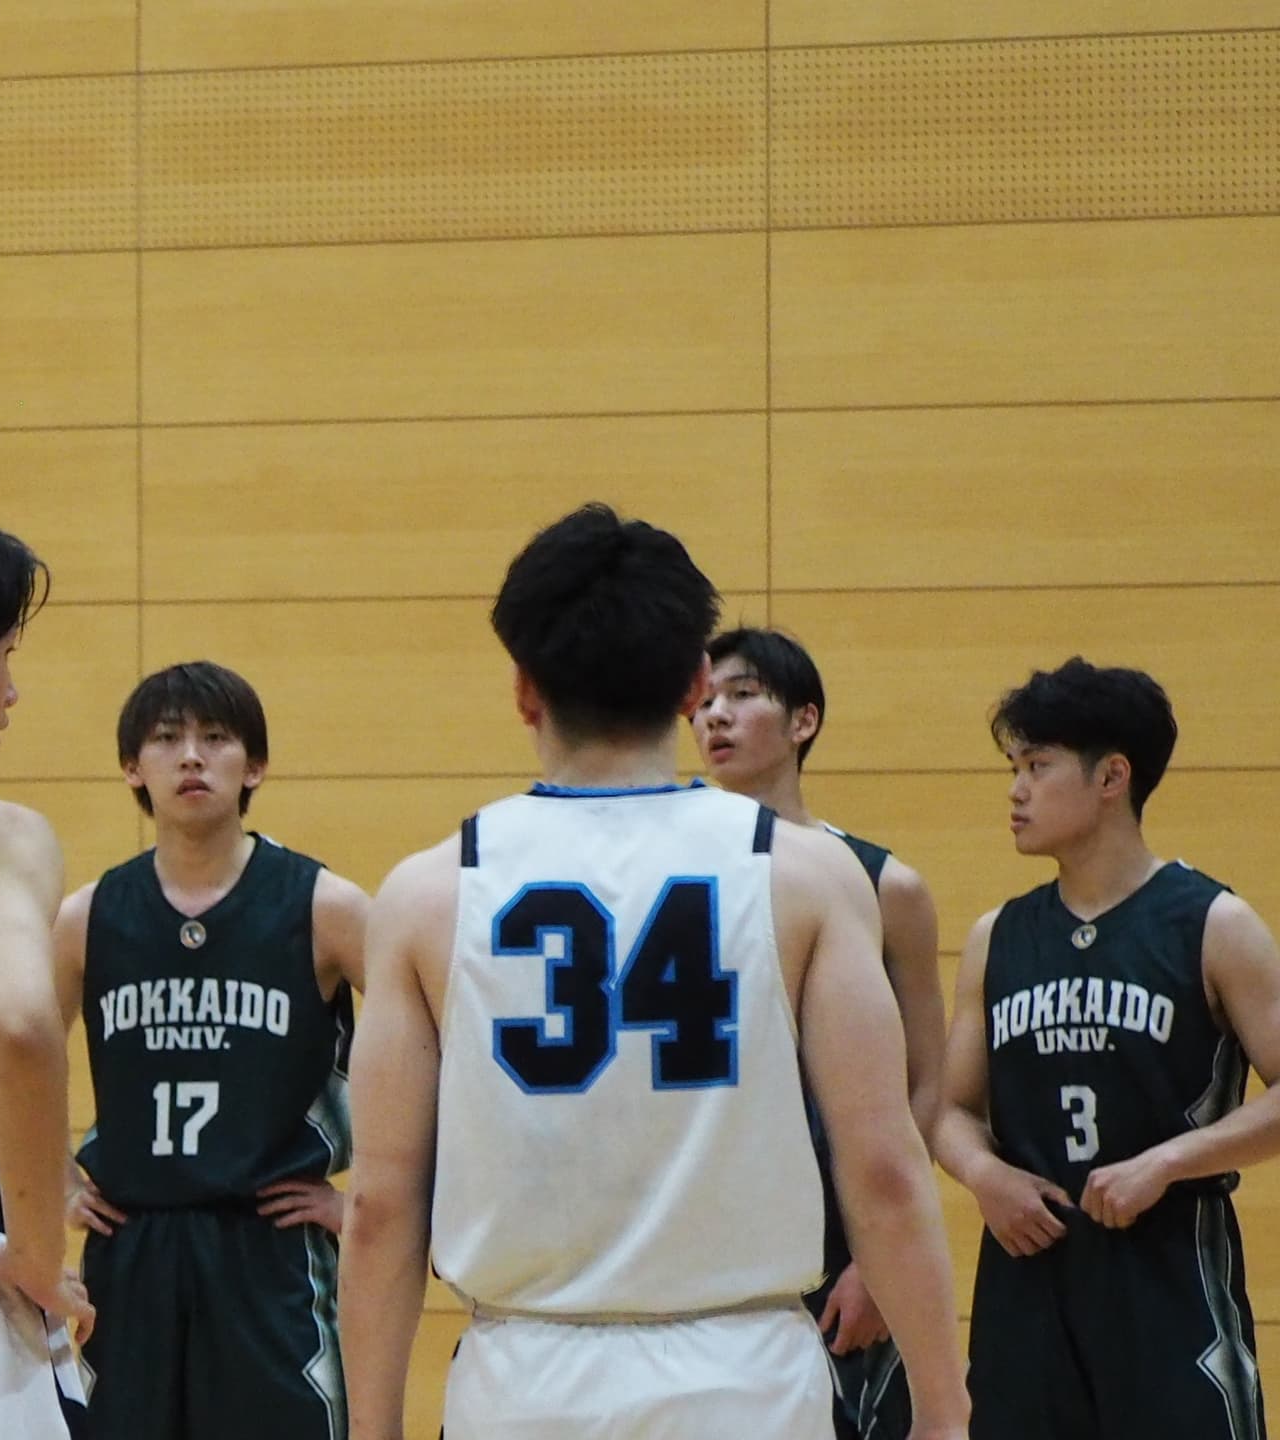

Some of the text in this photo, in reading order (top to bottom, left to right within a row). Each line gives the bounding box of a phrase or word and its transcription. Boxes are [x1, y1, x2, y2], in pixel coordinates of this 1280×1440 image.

[100, 977, 291, 1042] HOKKAIDO
[492, 876, 739, 1096] 34
[992, 976, 1175, 1051] HOKKAIDO
[145, 1025, 231, 1051] UNIV.
[1035, 1026, 1117, 1056] UNIV.
[152, 1081, 220, 1157] 17
[1060, 1084, 1100, 1163] 3
